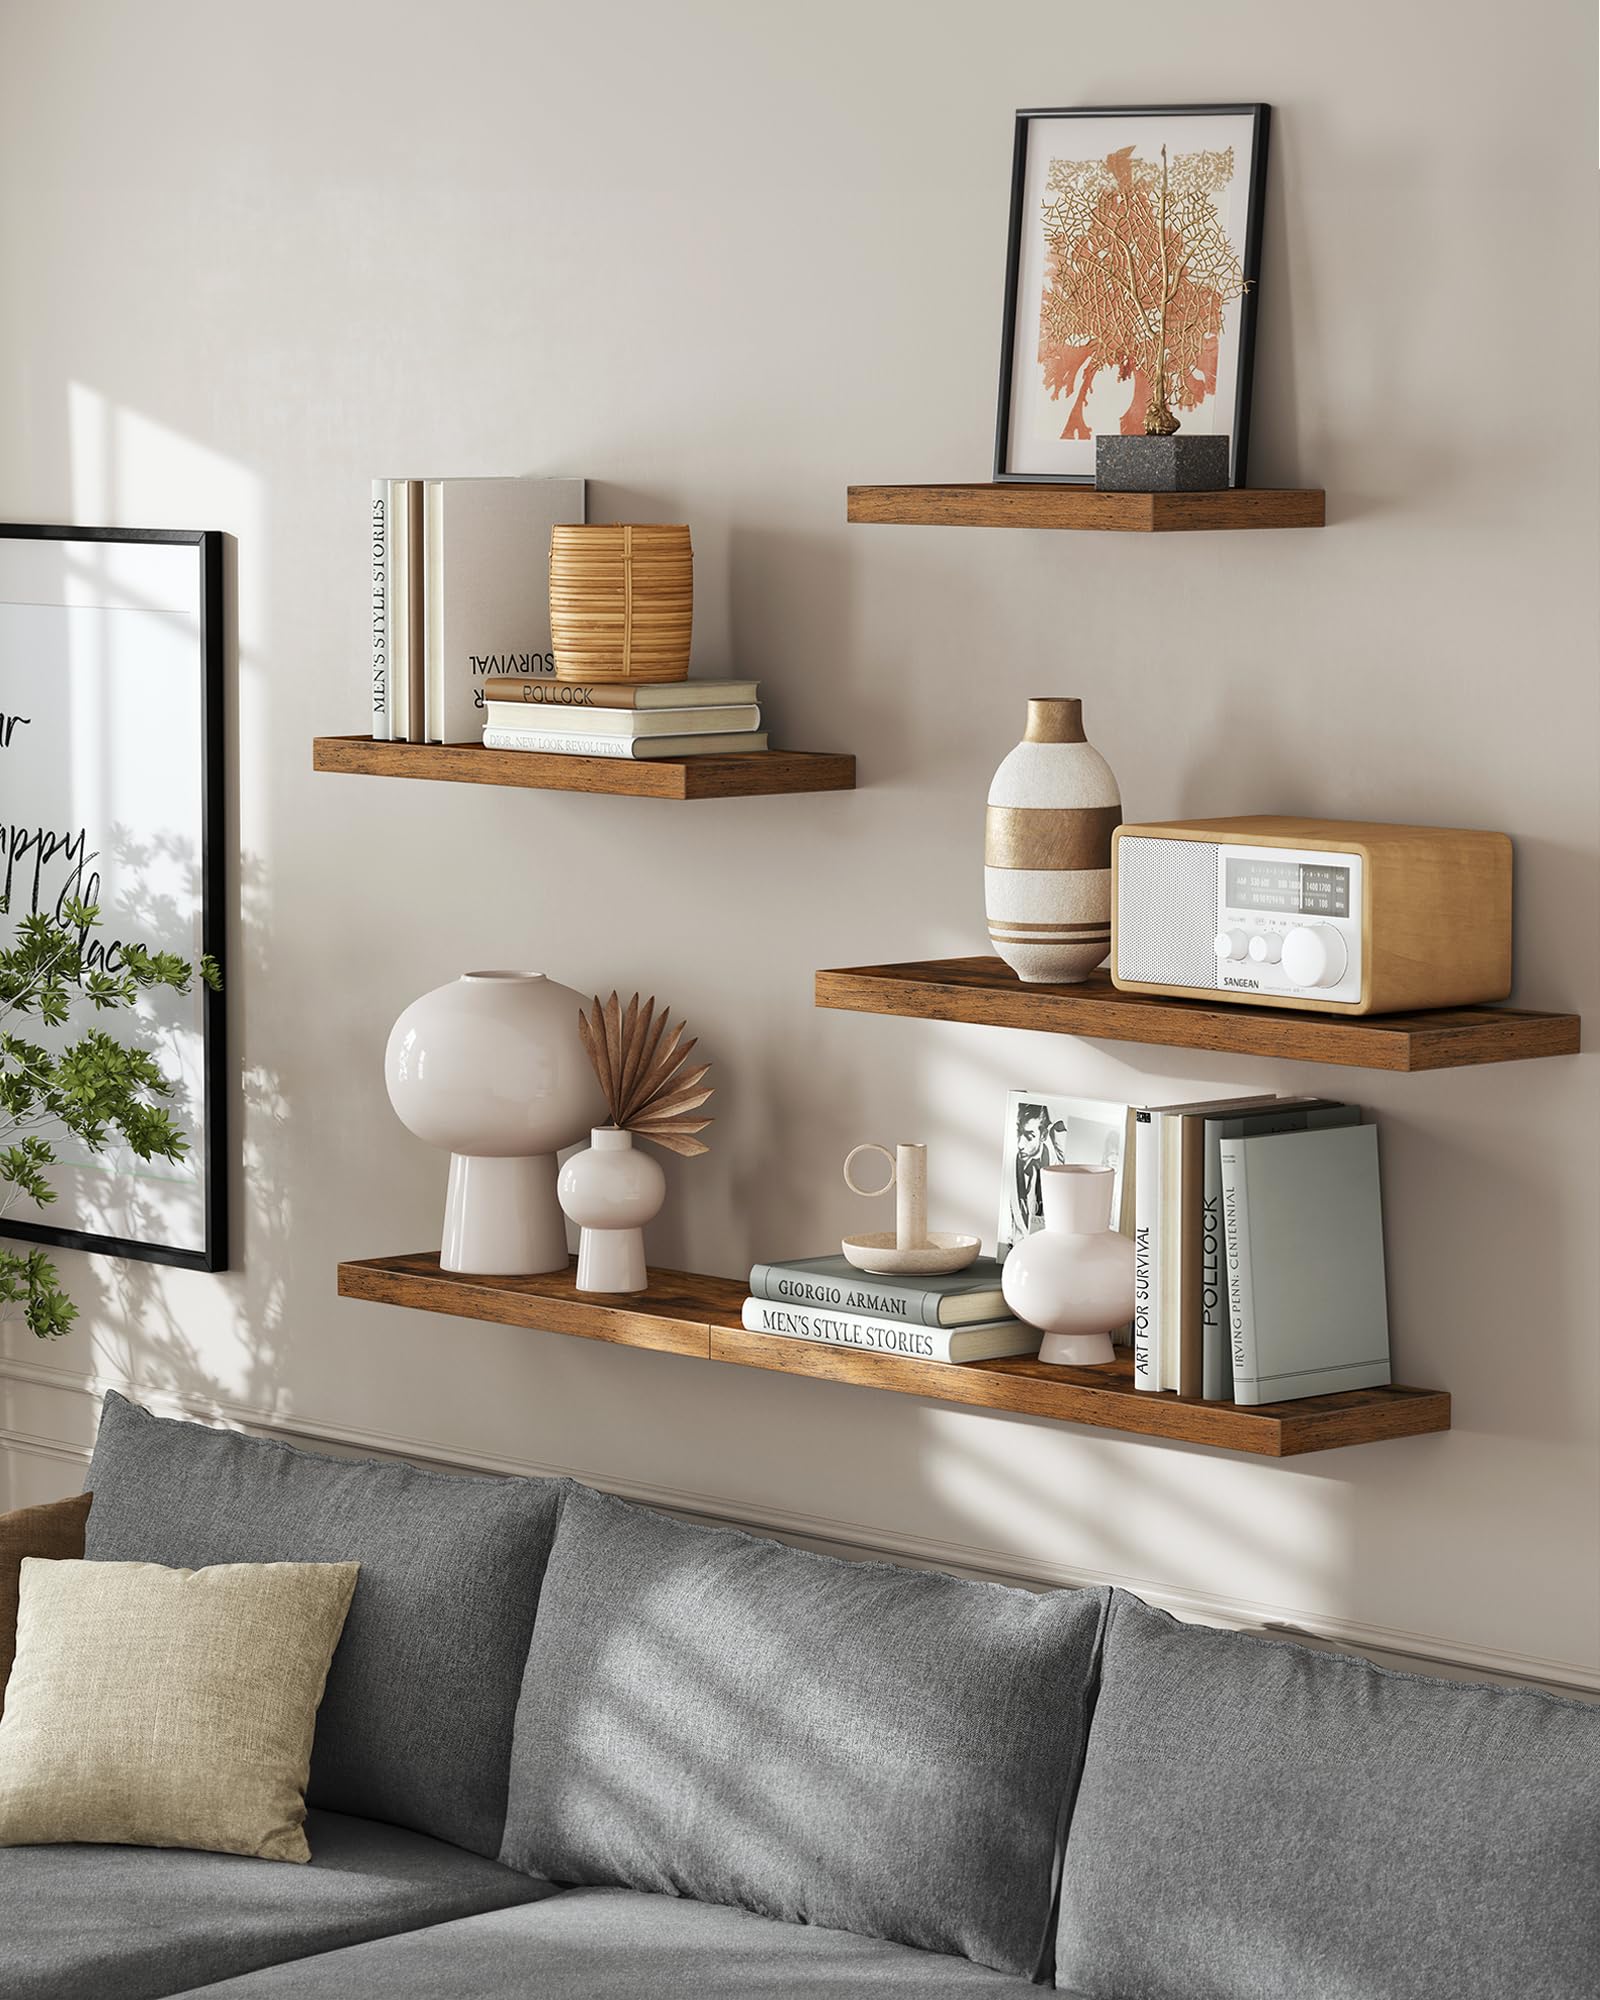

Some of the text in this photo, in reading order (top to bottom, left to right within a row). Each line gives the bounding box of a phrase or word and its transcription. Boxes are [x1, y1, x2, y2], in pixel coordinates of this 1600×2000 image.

[373, 499, 386, 714] MEN'S STYLE STORIES
[469, 652, 555, 675] SURVIVAL
[522, 684, 595, 705] POLLOCK
[515, 736, 537, 749] NEW
[538, 737, 566, 752] LOOK
[565, 740, 625, 756] REVOLUTION
[1223, 977, 1259, 989] SANGEAN
[1202, 1195, 1219, 1327] POLLOCK
[1225, 1186, 1246, 1368] IRVING PENN: CENTENNIAL
[777, 1279, 908, 1316] GIORGIO ARMANI
[1136, 1227, 1150, 1376] ART FOR SURVIVAL
[761, 1309, 934, 1356] MEN'S STYLE STORIES
